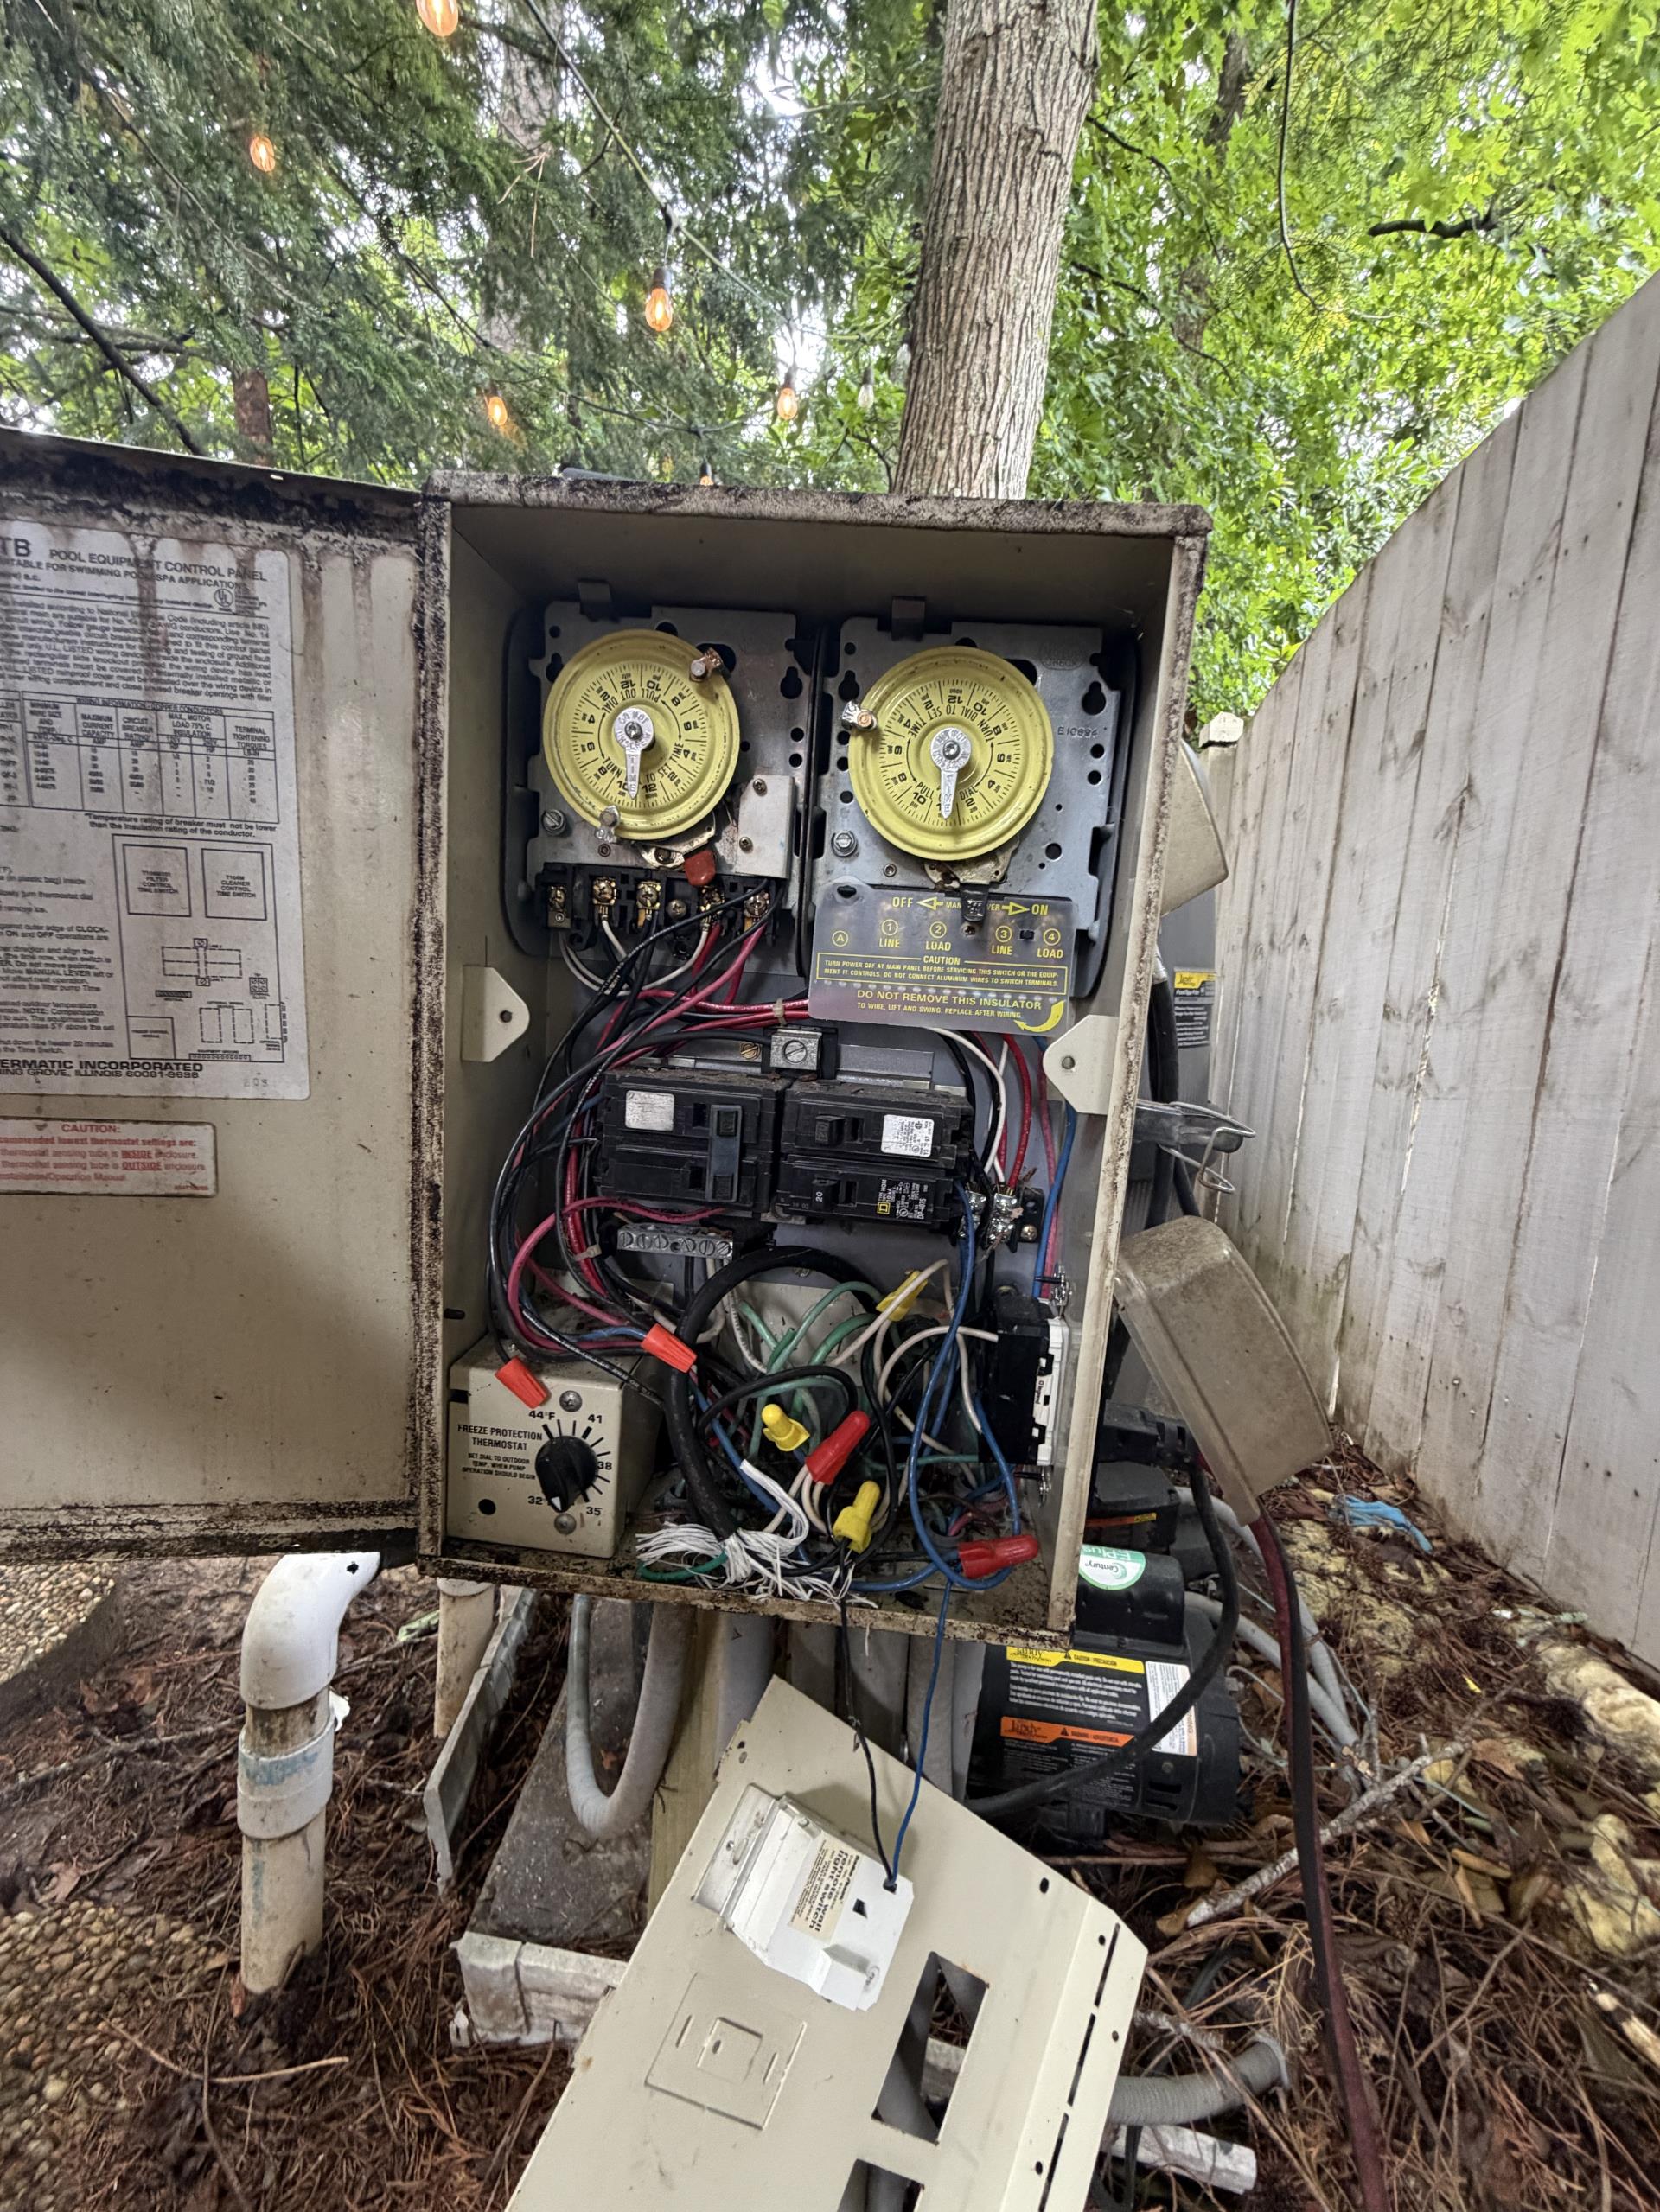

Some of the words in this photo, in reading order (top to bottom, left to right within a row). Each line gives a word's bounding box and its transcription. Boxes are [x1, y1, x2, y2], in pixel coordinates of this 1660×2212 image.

[46, 562, 67, 572] FOR
[69, 564, 122, 577] SWIMMING
[49, 549, 86, 562] POOL
[165, 562, 225, 577] CONTROL
[227, 568, 267, 582] PANEL
[620, 679, 635, 689] 12
[647, 680, 661, 691] 10
[620, 688, 636, 701] OUT
[641, 688, 661, 703] PULL
[948, 695, 963, 704] 12
[671, 697, 680, 706] 8
[588, 715, 595, 724] 4
[683, 749, 691, 759] 4
[603, 757, 622, 778] TURN
[645, 774, 655, 782] TO
[642, 783, 657, 793] 12
[916, 781, 934, 800] PULL
[960, 787, 979, 800] DIAL
[913, 792, 927, 805] 10
[175, 819, 204, 827] breaker
[165, 826, 188, 834] rating
[214, 829, 256, 838] conductor.
[892, 896, 914, 908] OFF
[1031, 904, 1049, 915] ON
[879, 938, 900, 948] LINE
[925, 941, 951, 951] LOAD
[992, 945, 1012, 955] LINE
[1038, 948, 1063, 959] LOAD
[923, 955, 961, 966] CAUTION
[858, 990, 873, 998] DO
[877, 991, 900, 1000] NOT
[903, 993, 948, 1004] REMOVE
[952, 996, 976, 1004] THIS
[980, 998, 1042, 1010] INSULATOR
[79, 1060, 203, 1072] INCORPORATED
[61, 1124, 120, 1133] CAUTION:
[815, 1191, 824, 1202] 20
[588, 1414, 603, 1424] 41
[457, 1424, 488, 1434] FREEZE
[490, 1427, 543, 1441] PROTECTION
[472, 1437, 528, 1450] THERMOSTAT
[597, 1461, 612, 1470] 38
[586, 1506, 602, 1516] 35
[828, 1850, 845, 1880] light
[827, 1852, 848, 1900] remote
[809, 1884, 830, 1928] switch
[814, 1903, 829, 1932] wall
